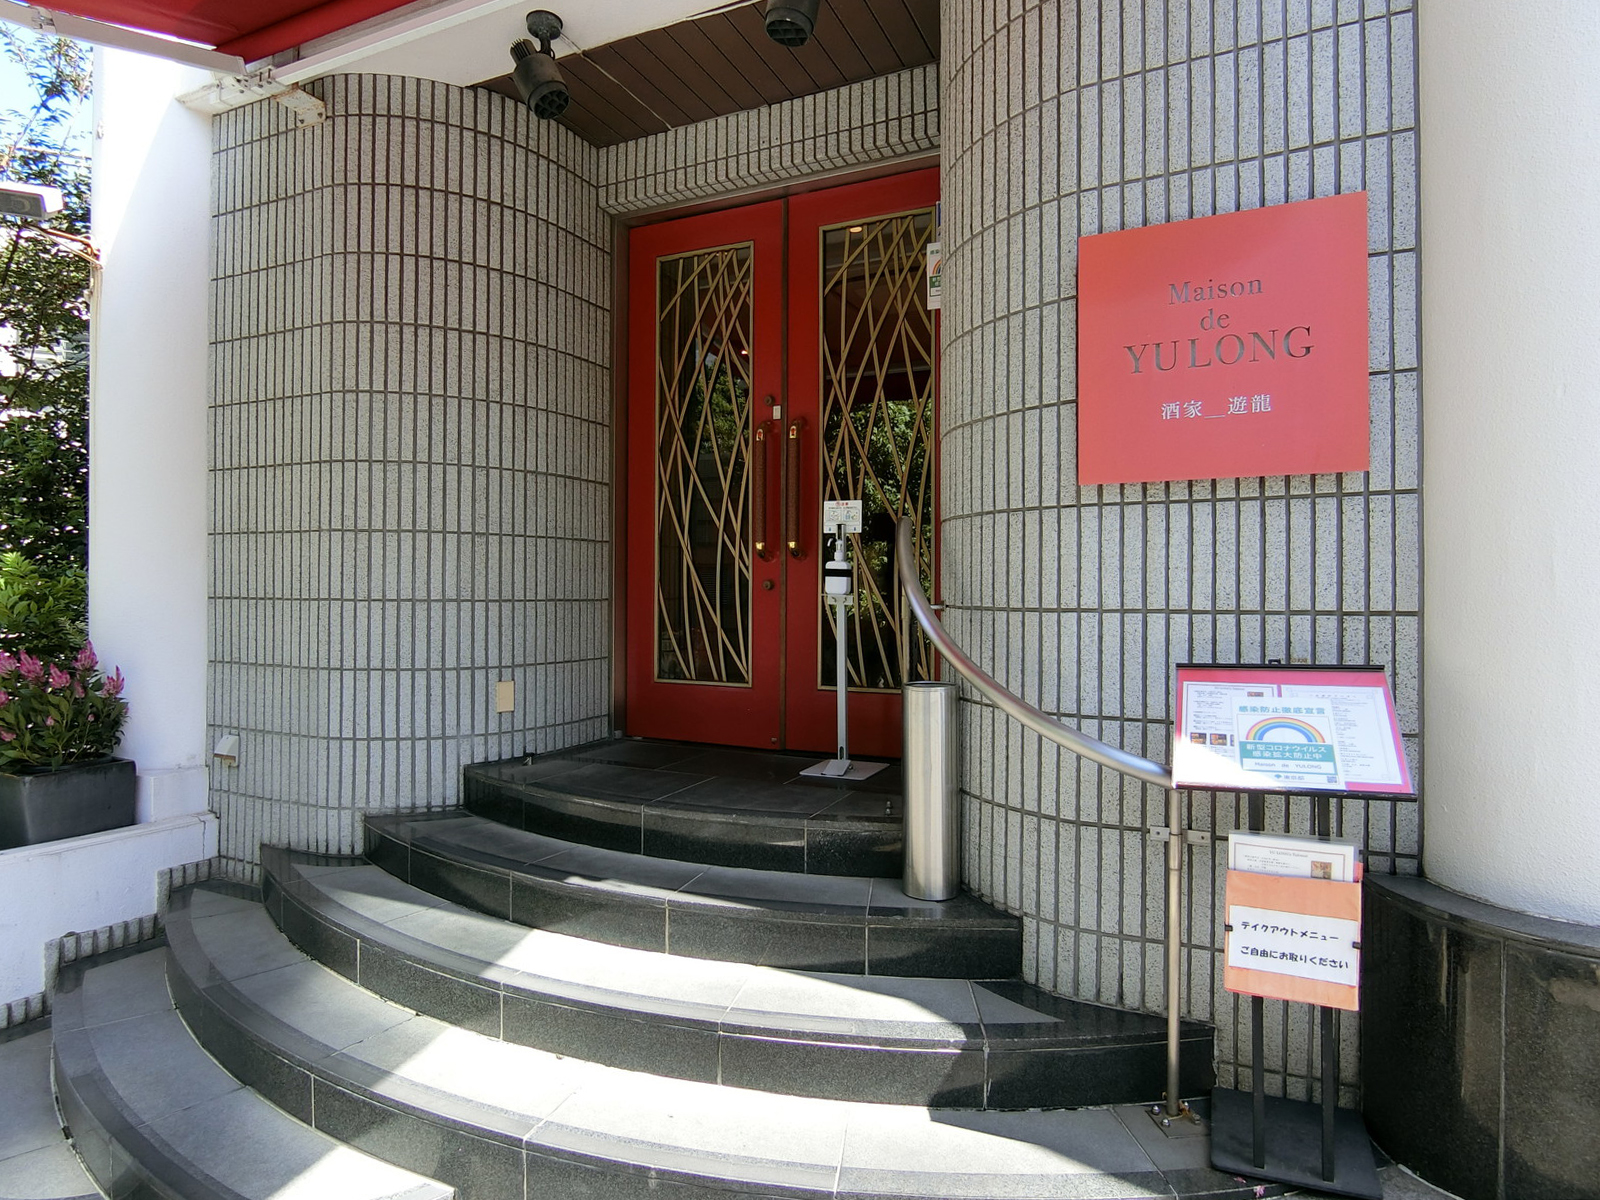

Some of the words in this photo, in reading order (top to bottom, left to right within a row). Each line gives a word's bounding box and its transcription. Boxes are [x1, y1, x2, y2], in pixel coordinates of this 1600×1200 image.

[1169, 278, 1264, 305] Maison
[1200, 308, 1231, 331] de
[1123, 326, 1315, 374] YULONG
[1239, 705, 1326, 715] 感染防止徹底宣言
[1246, 743, 1327, 753] 新型コロナウイルス
[1252, 750, 1322, 760] 感染拡大防止中
[1241, 921, 1339, 941] テイクアウトメニュー
[1240, 945, 1349, 969] ご自由にお取りください
